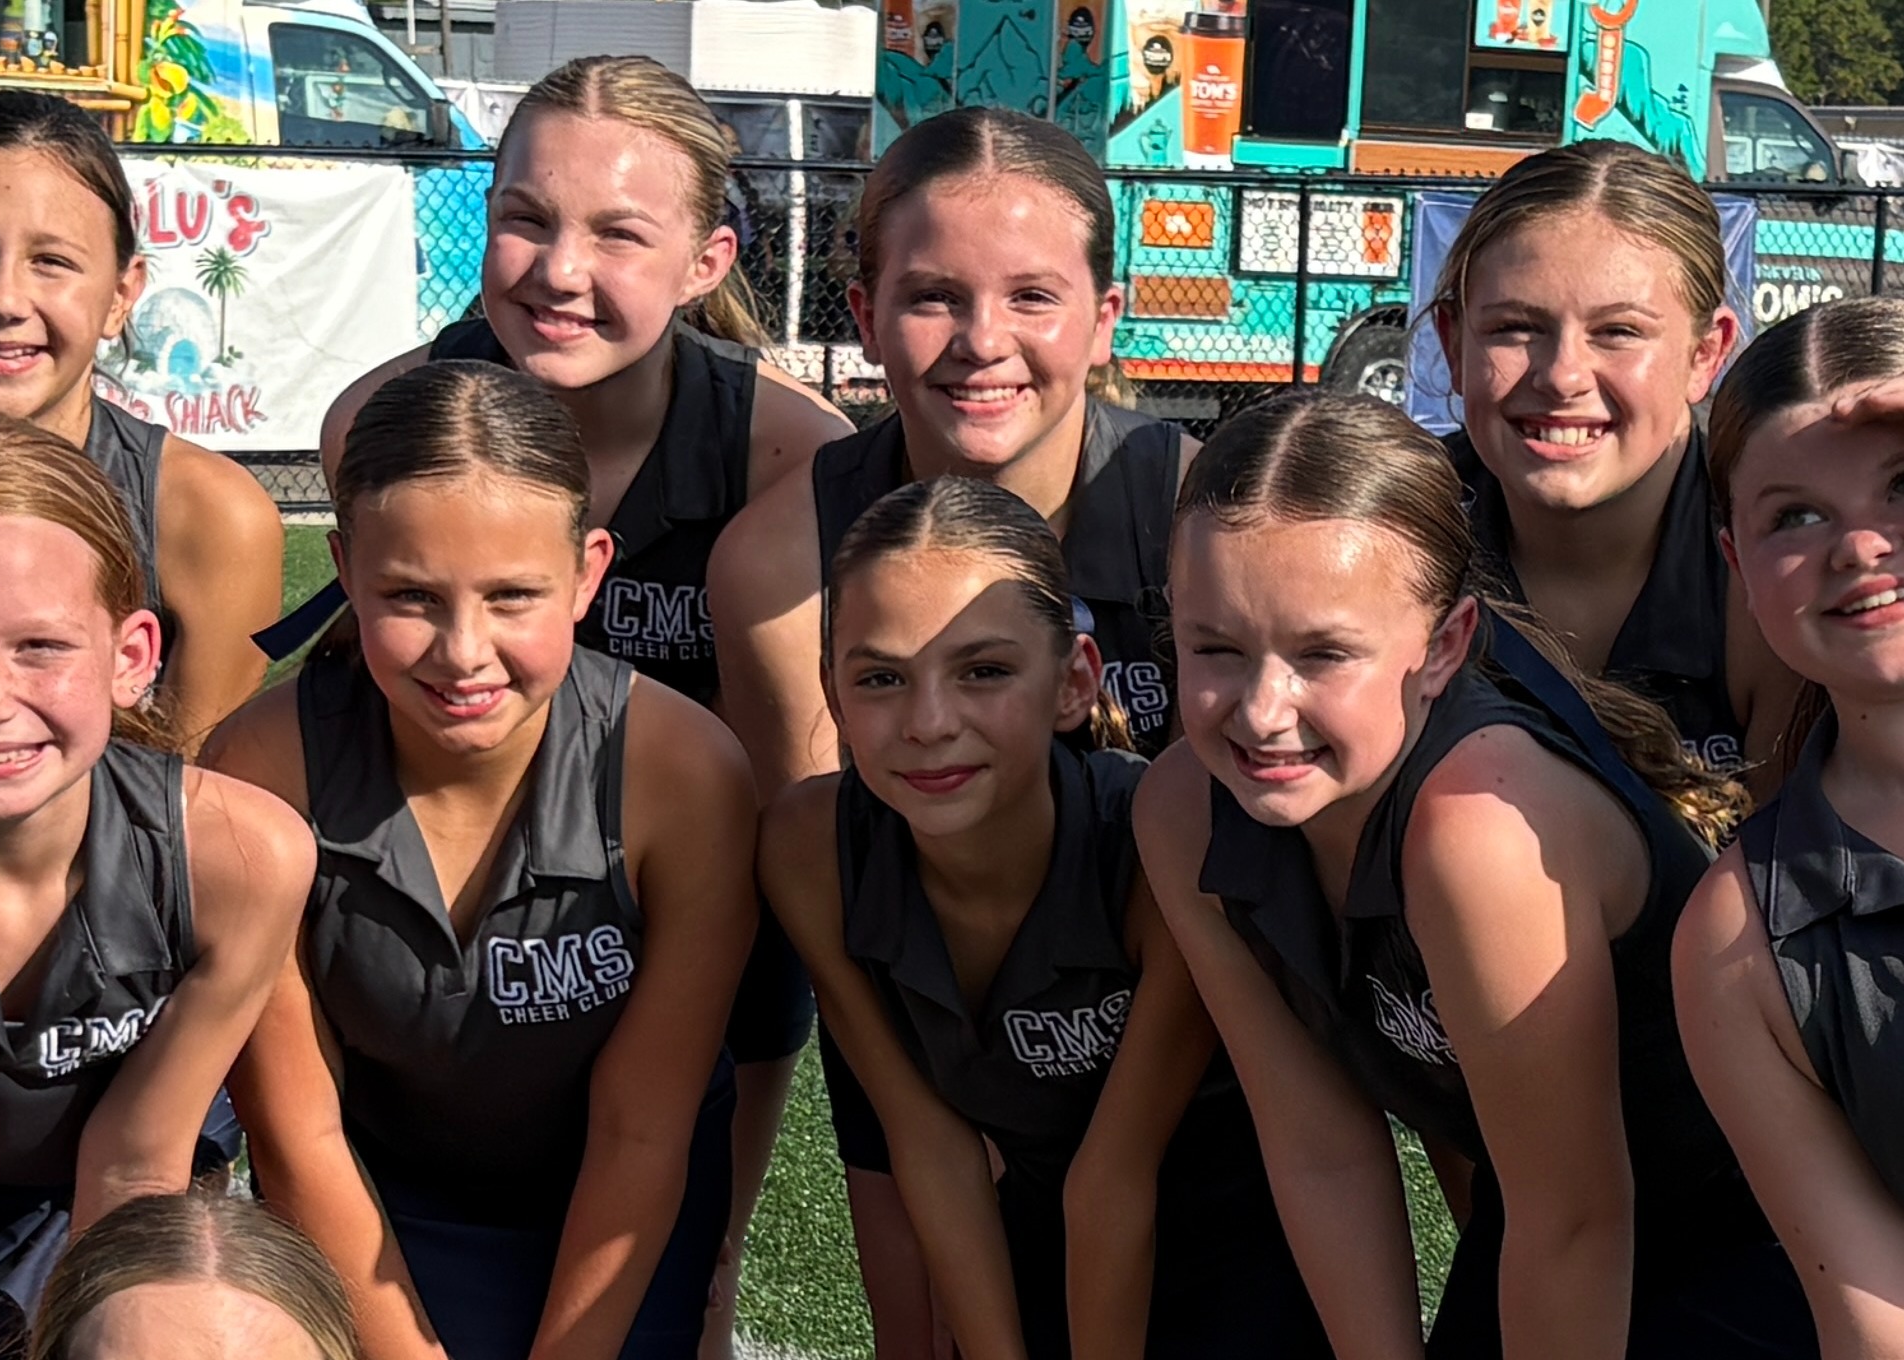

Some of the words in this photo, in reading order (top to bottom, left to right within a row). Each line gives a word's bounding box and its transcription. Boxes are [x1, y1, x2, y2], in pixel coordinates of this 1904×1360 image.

[1189, 79, 1238, 101] TOM'S
[130, 178, 270, 256] LU'S
[164, 383, 269, 436] SHACK
[608, 637, 670, 661] CHEER
[487, 924, 635, 1007] CMS
[498, 1003, 571, 1026] CHEER
[577, 979, 631, 1013] CLUB
[39, 995, 170, 1069] CM
